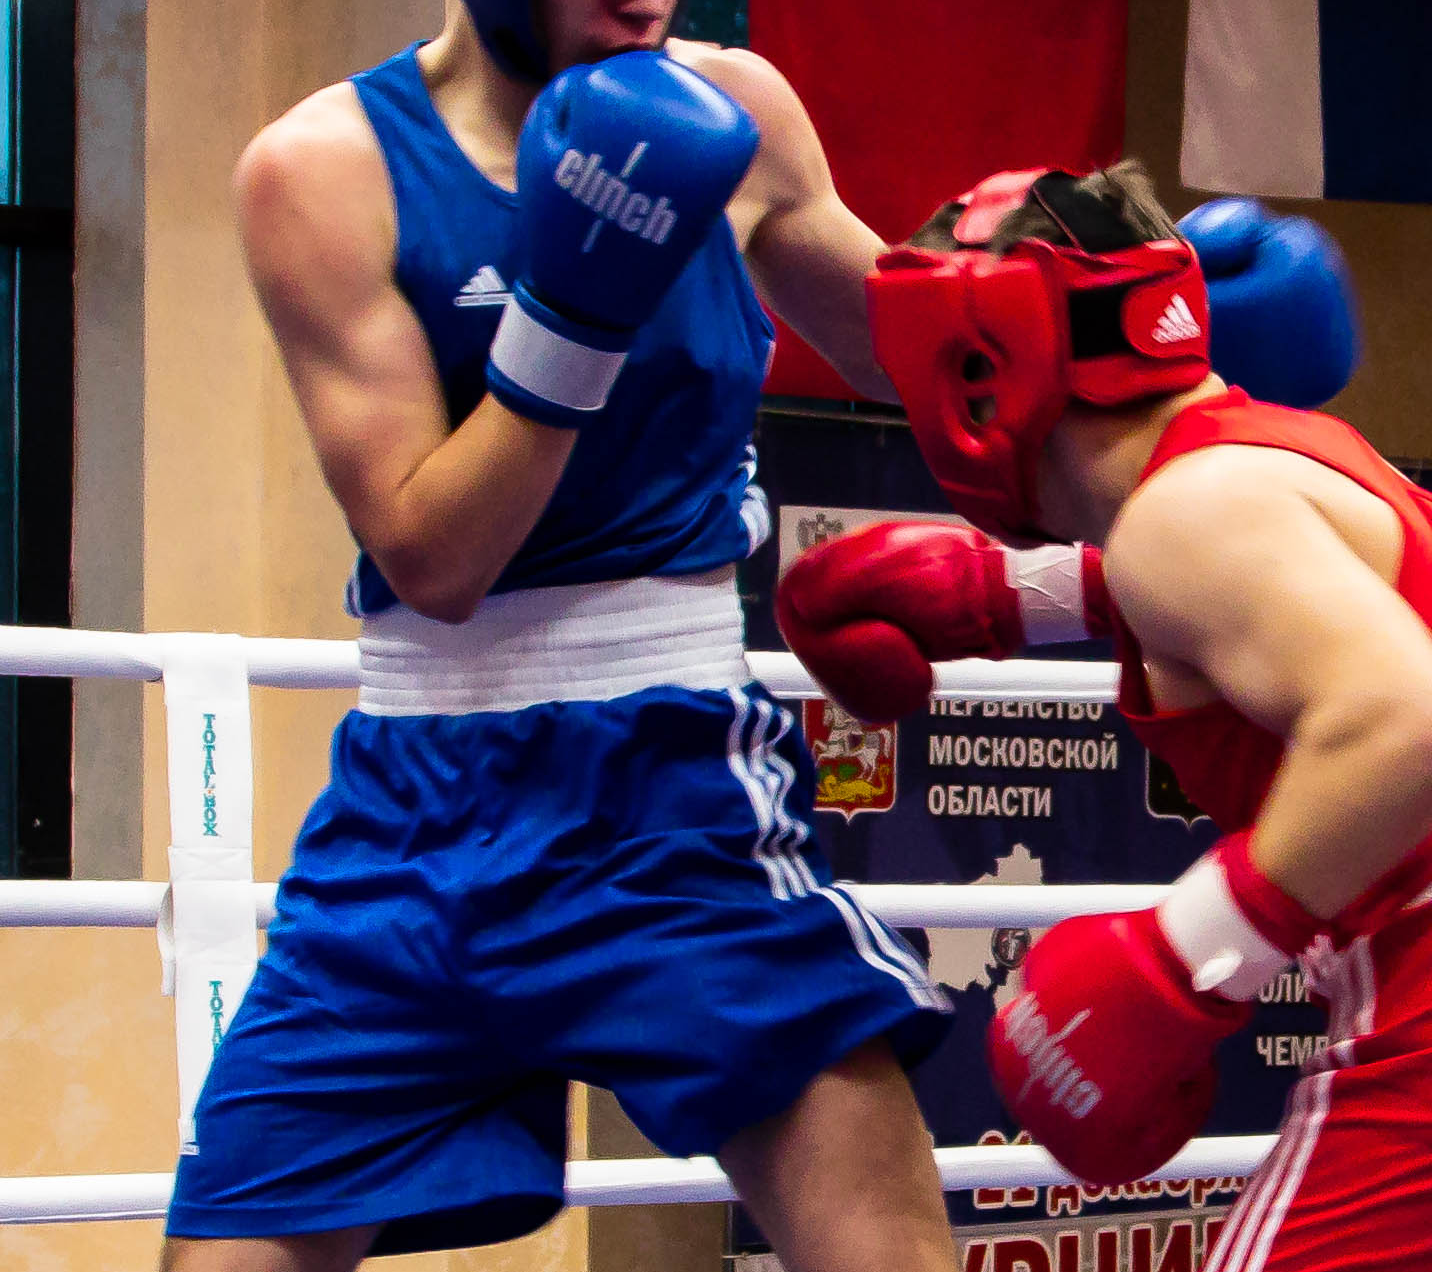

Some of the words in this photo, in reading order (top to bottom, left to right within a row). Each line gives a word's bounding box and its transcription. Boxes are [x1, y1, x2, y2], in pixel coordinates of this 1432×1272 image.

[554, 143, 678, 250] clinch
[201, 712, 217, 789] TOTAL
[928, 732, 1118, 770] МОСКОВСКОЙ
[202, 793, 219, 837] BOX
[928, 784, 1052, 818] ОБЛАСТИ
[208, 979, 224, 1057] TOTA
